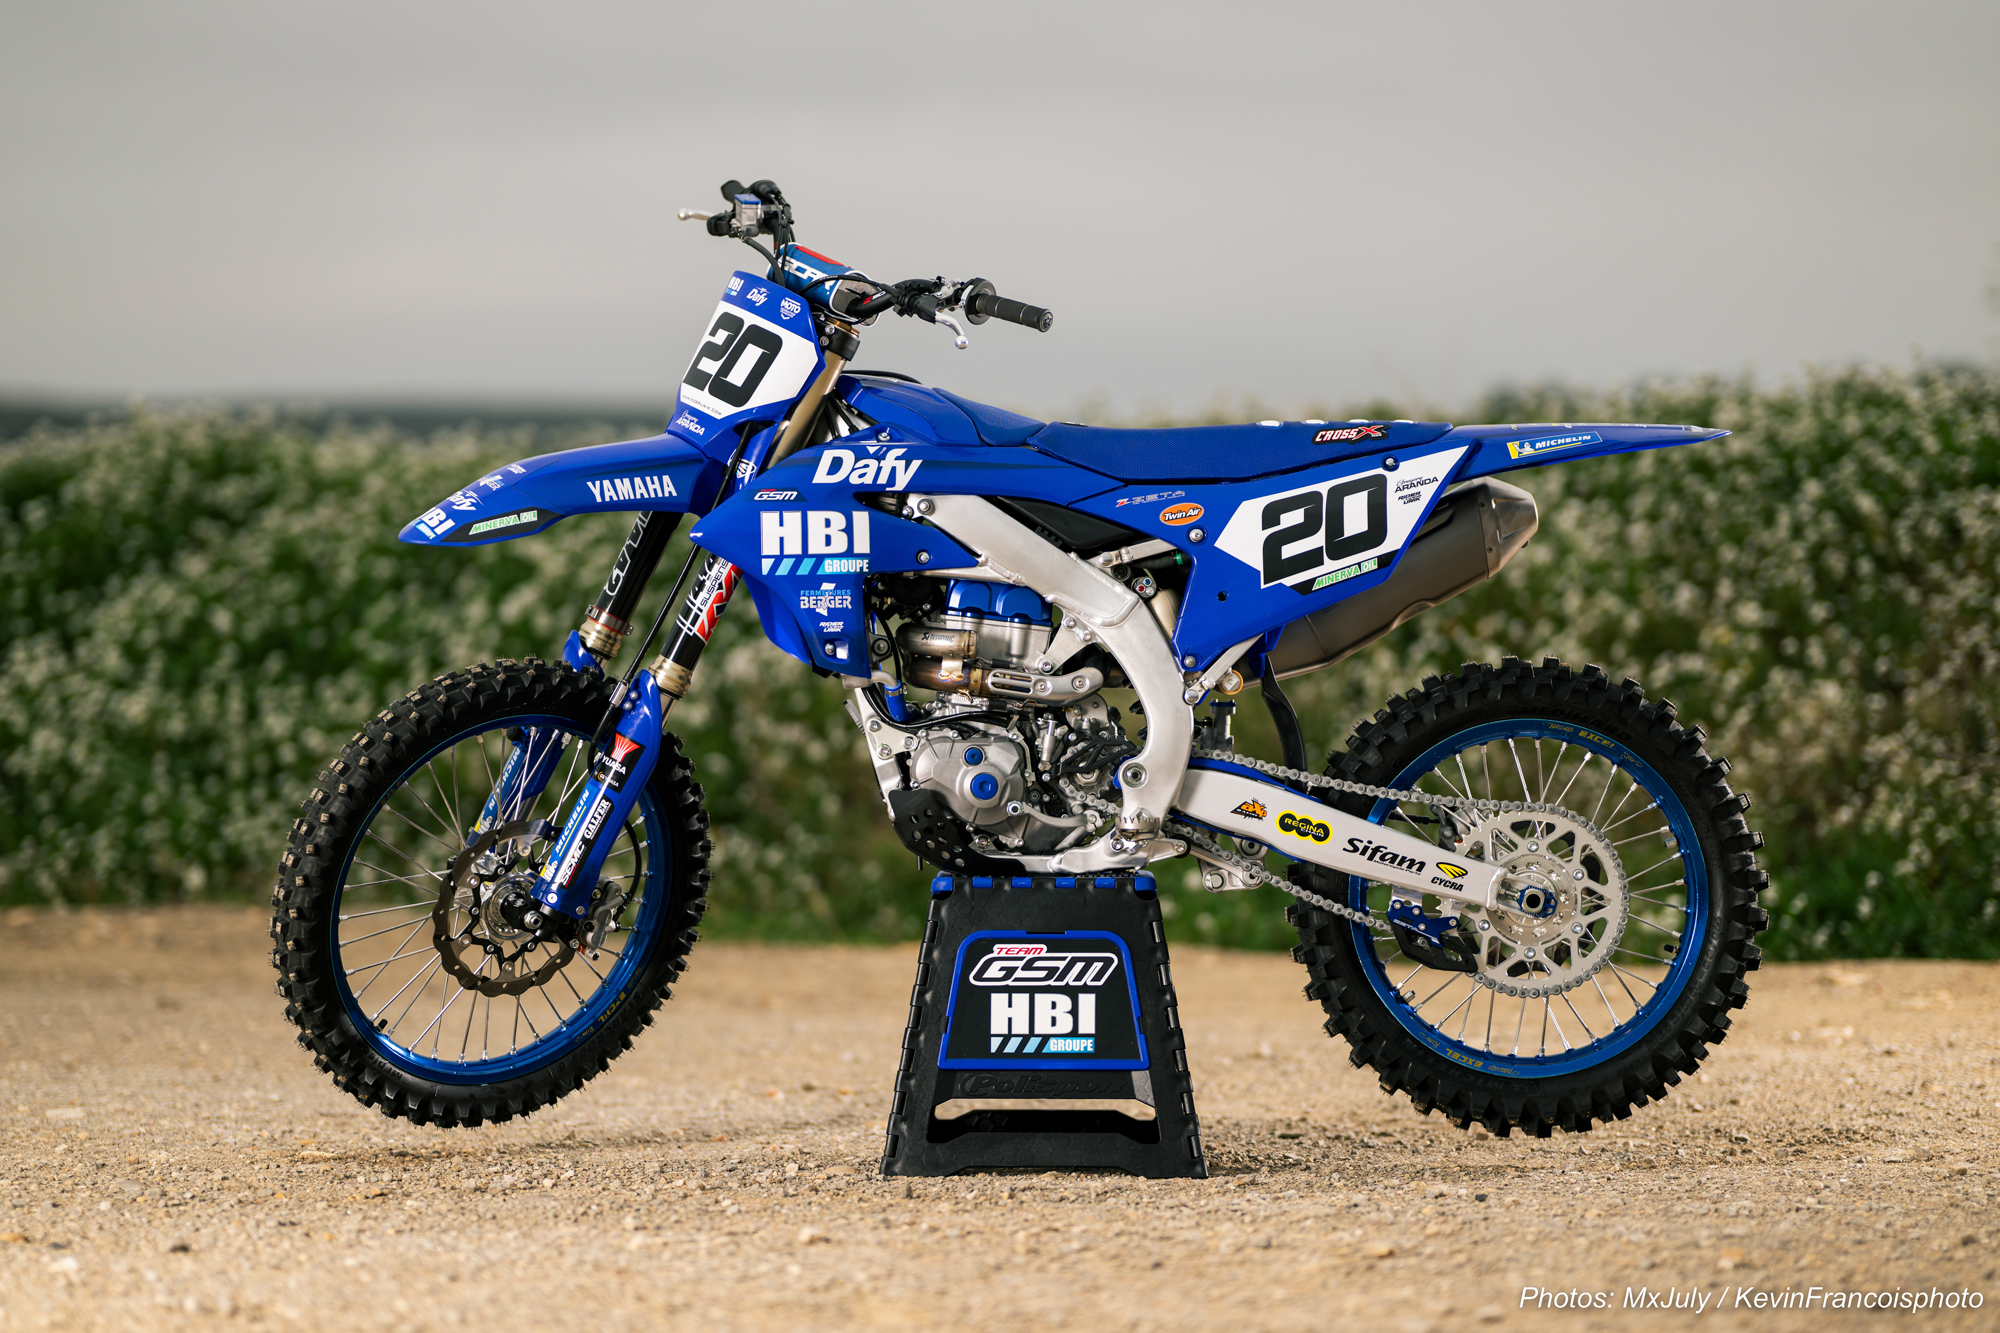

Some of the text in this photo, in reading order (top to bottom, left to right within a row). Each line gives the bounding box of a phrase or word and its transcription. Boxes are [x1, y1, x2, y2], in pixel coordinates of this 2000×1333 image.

[746, 287, 768, 306] Dafy
[780, 298, 801, 314] MOTO
[682, 311, 783, 408] 20
[676, 417, 706, 436] ARANDA
[1535, 434, 1592, 449] MICHELIN
[812, 446, 923, 491] Dafy
[586, 475, 678, 502] YAMAHA
[1394, 476, 1439, 494] ARANDA
[754, 491, 798, 500] GSM
[1398, 491, 1421, 500] RIDER
[468, 510, 538, 536] MINERVA OIL
[1164, 508, 1202, 522] Twin Air
[760, 510, 870, 556] HBI
[1262, 474, 1388, 585] 20
[824, 559, 870, 573] GROUPE
[1312, 558, 1378, 591] MINERVA OIL
[800, 596, 852, 610] BERGER
[1578, 730, 1616, 748] EXCEL
[602, 754, 626, 775] YUASA
[554, 788, 590, 854] MICHELIN
[584, 799, 610, 840] GALFER
[1284, 818, 1324, 834] REGINA
[1300, 828, 1324, 838] CHAIN
[561, 840, 586, 886] SEMC
[1342, 838, 1426, 872] Sifam
[1431, 876, 1464, 892] CYCRA
[994, 946, 1044, 956] TEAM
[970, 954, 1117, 985] GSM
[990, 993, 1096, 1034] HBI
[1050, 1039, 1094, 1052] GROUPE
[1446, 1048, 1484, 1068] EXCEL
[960, 1072, 1128, 1096] Polisport
